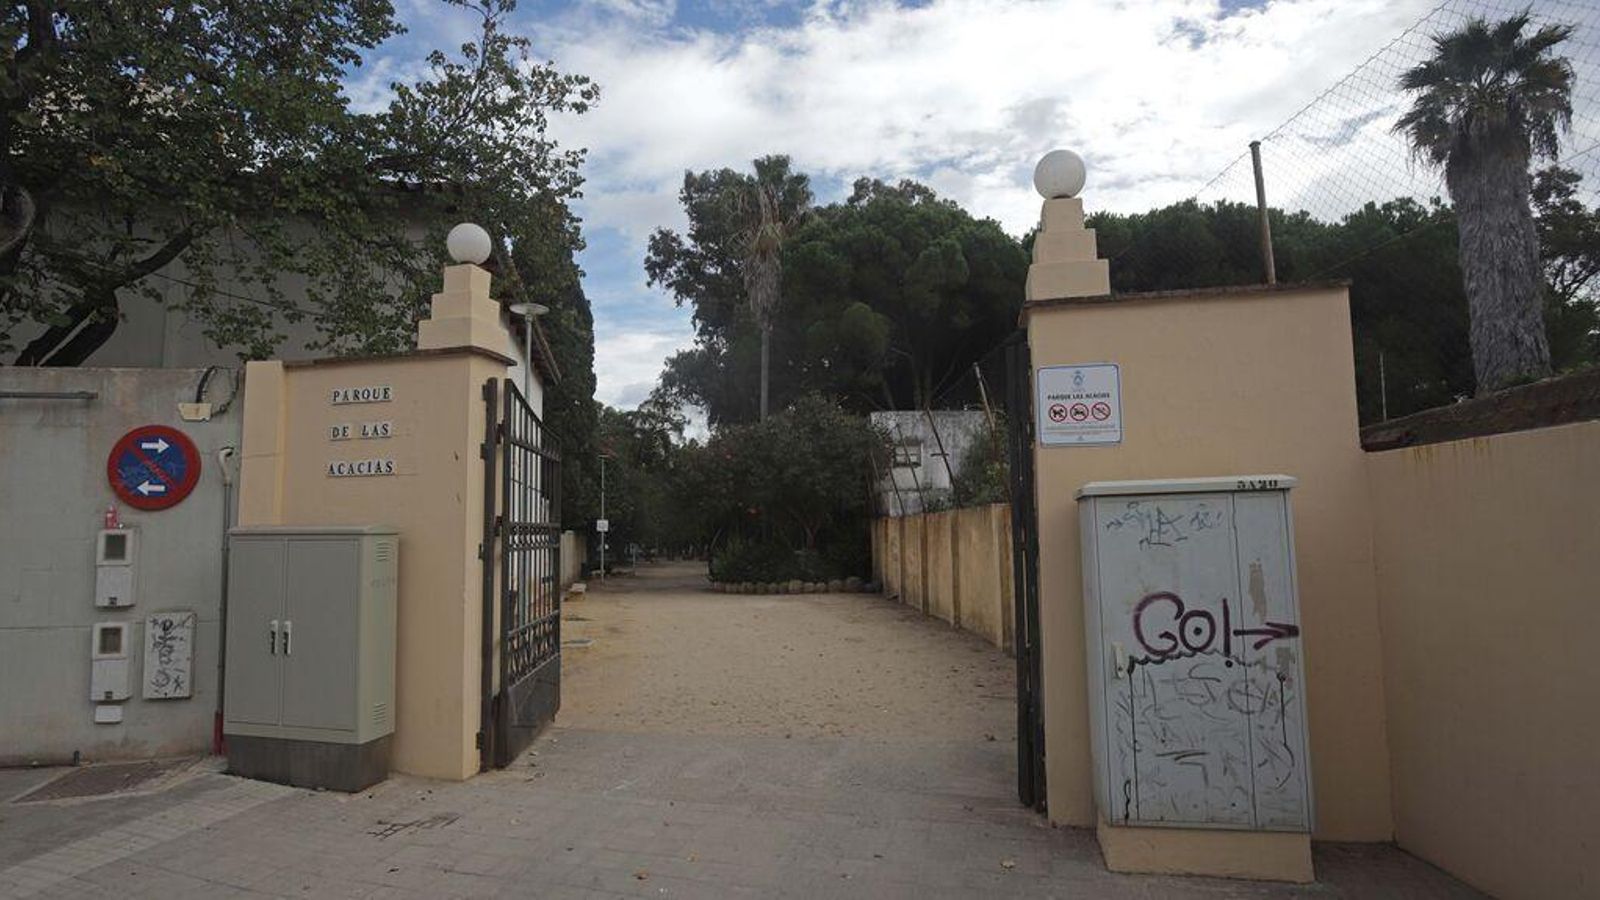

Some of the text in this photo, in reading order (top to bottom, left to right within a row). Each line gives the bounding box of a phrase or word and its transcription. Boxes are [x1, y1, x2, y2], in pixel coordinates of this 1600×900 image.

[333, 387, 390, 402] PARQUE
[332, 423, 389, 439] DE LAS
[328, 460, 393, 475] ACACIAS
